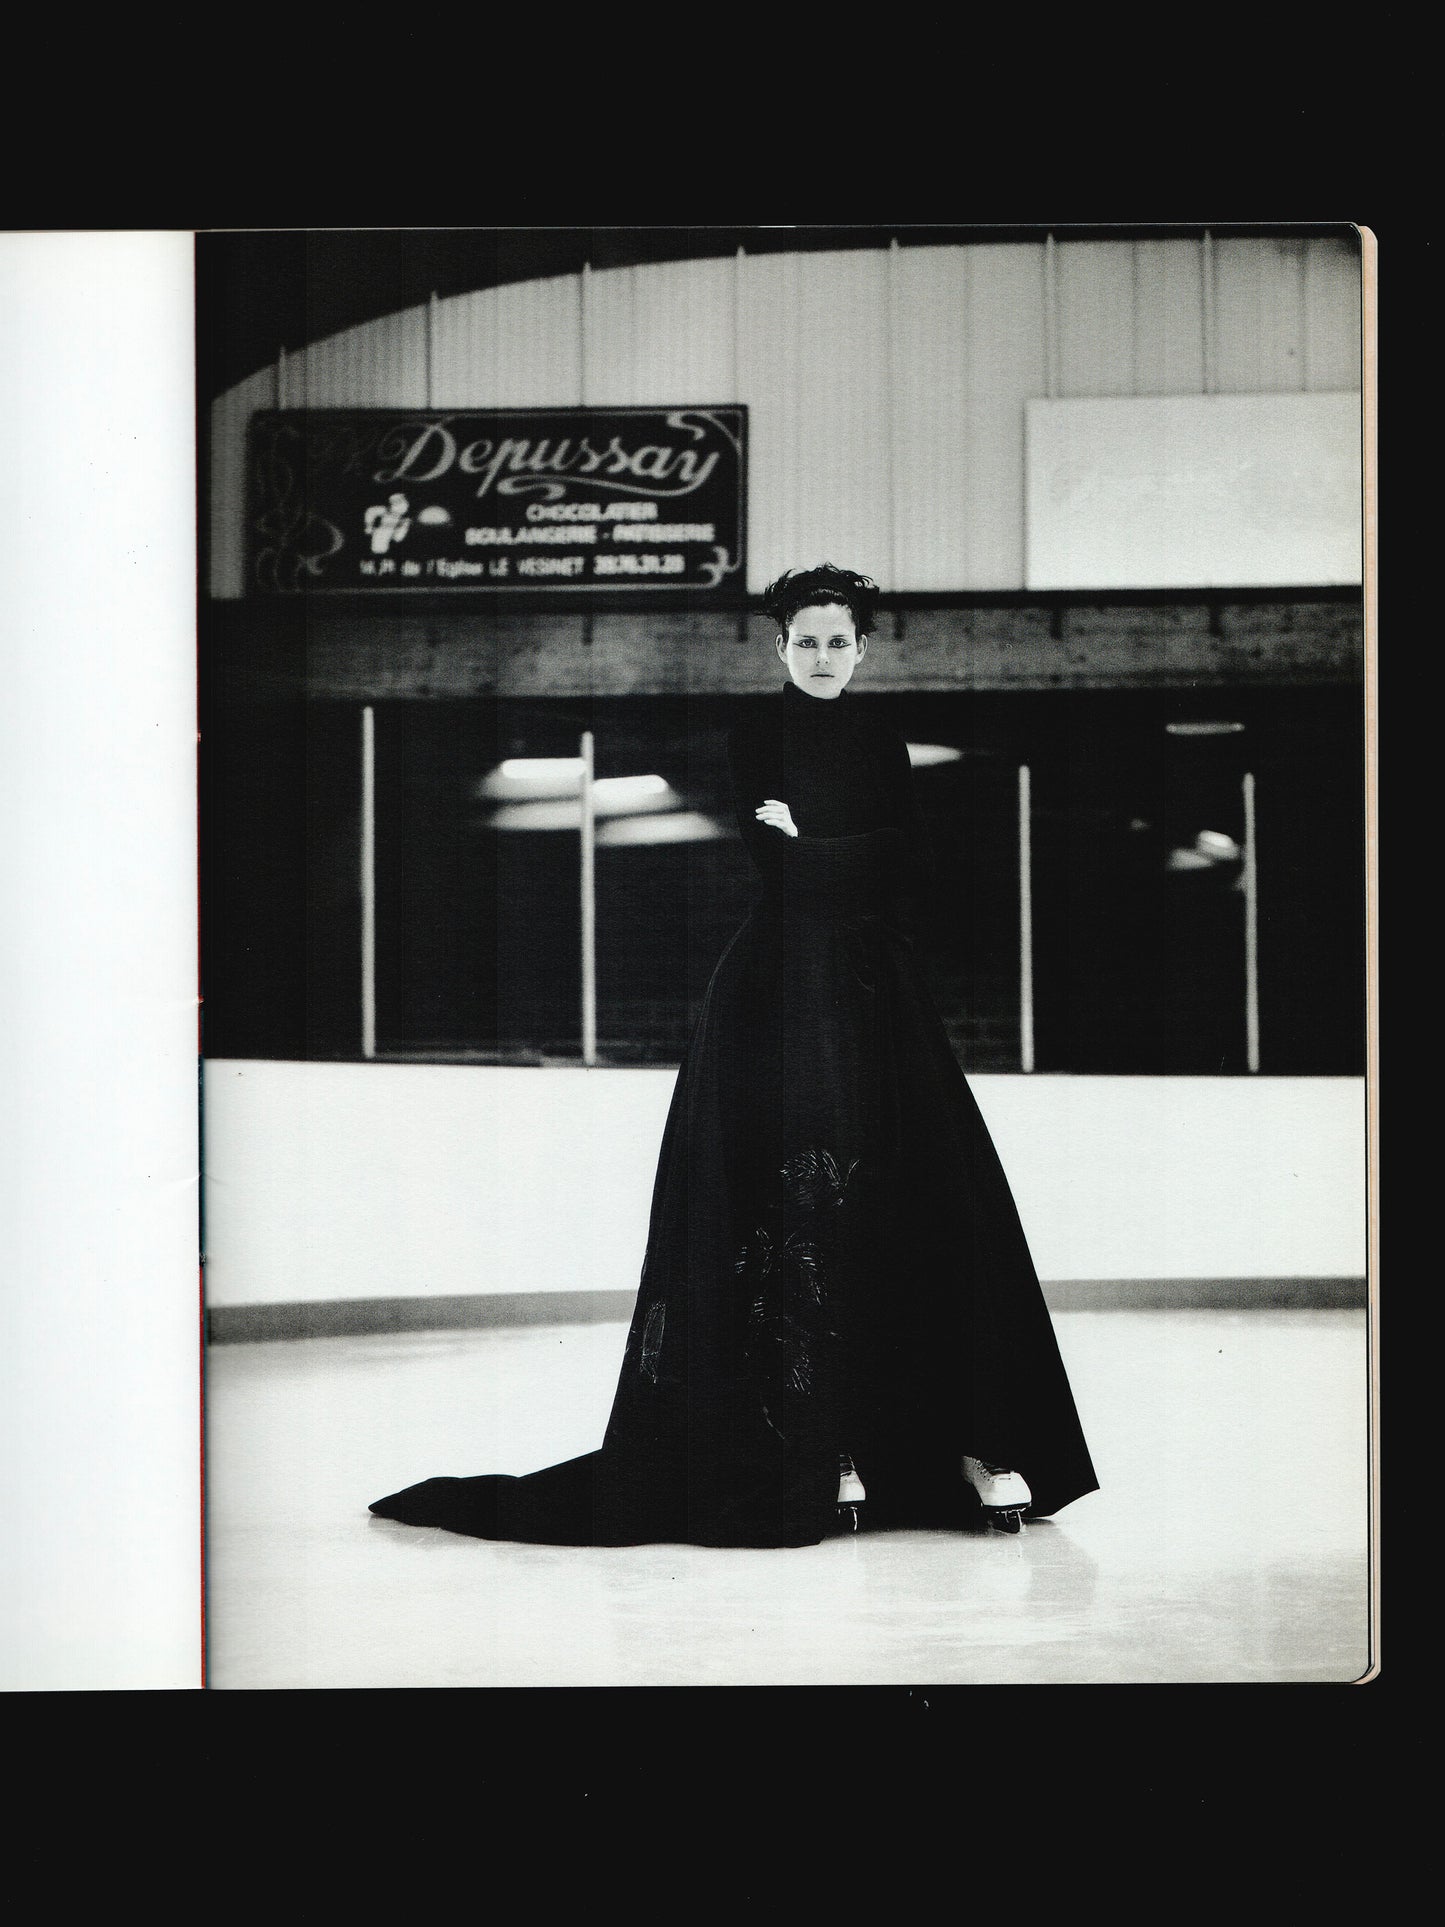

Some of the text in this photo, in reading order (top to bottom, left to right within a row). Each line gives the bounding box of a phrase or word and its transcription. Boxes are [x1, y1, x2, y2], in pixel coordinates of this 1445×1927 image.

[373, 420, 720, 500] Depussay
[525, 502, 658, 522] CHOCOLATIER
[464, 526, 598, 546] BOULANGERIE
[489, 557, 509, 577] LE
